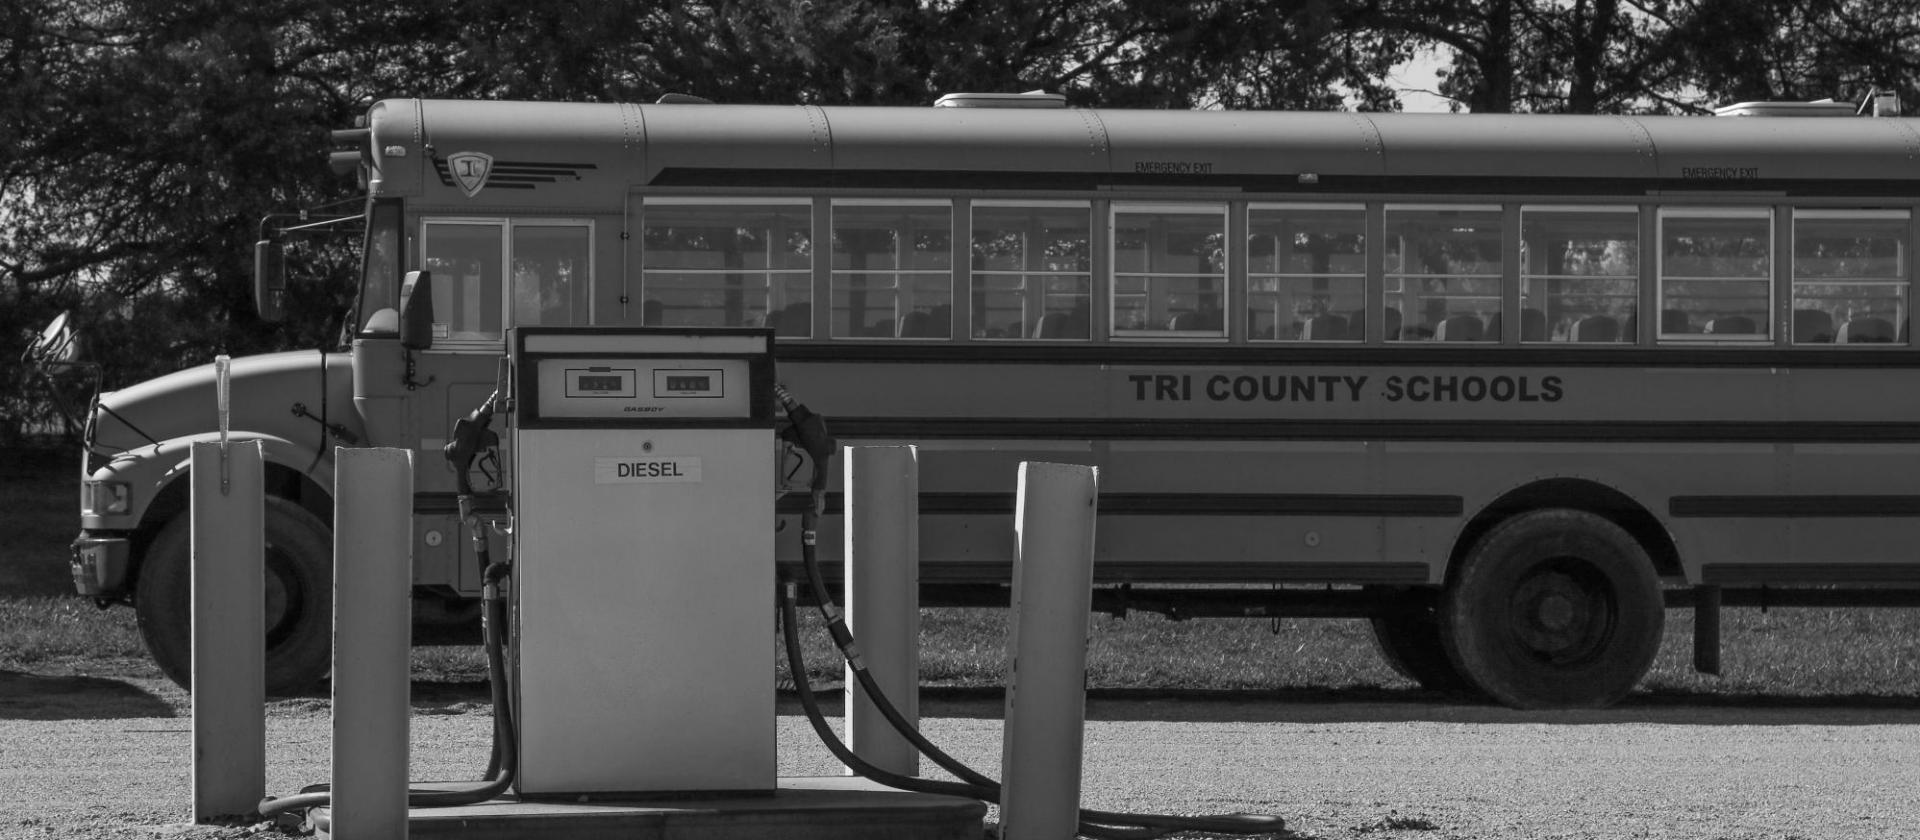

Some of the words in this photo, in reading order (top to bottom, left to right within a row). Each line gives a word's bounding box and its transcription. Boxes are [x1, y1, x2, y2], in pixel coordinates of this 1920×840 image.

[1135, 161, 1191, 174] EMERGENCY
[1193, 162, 1213, 174] EXIT
[1682, 167, 1738, 178] EMERGENCY
[1740, 168, 1759, 178] EXIT
[1129, 375, 1191, 401] TRI
[1206, 374, 1368, 402] COUNTY
[1384, 375, 1564, 402] SCHOOLS
[617, 462, 683, 477] DIESEL
